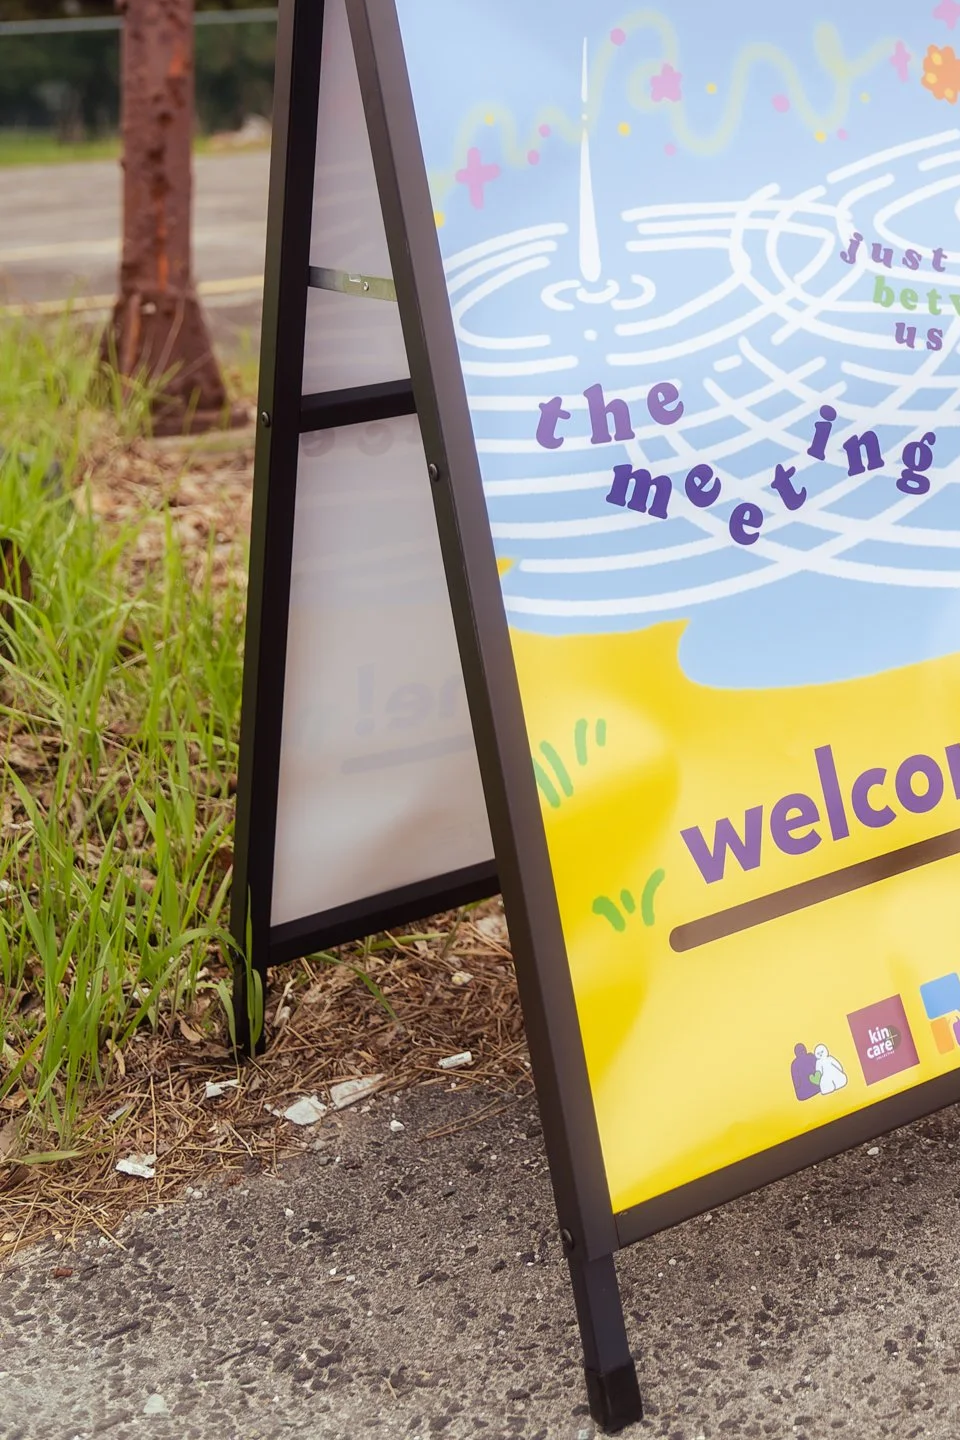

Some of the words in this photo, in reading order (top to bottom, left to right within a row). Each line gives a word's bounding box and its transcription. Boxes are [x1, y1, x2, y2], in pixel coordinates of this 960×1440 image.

[840, 232, 948, 272] just
[895, 322, 943, 351] us
[534, 382, 684, 449] the
[606, 405, 936, 545] meeting
[866, 1039, 894, 1059] care
[868, 1026, 890, 1044] kin
